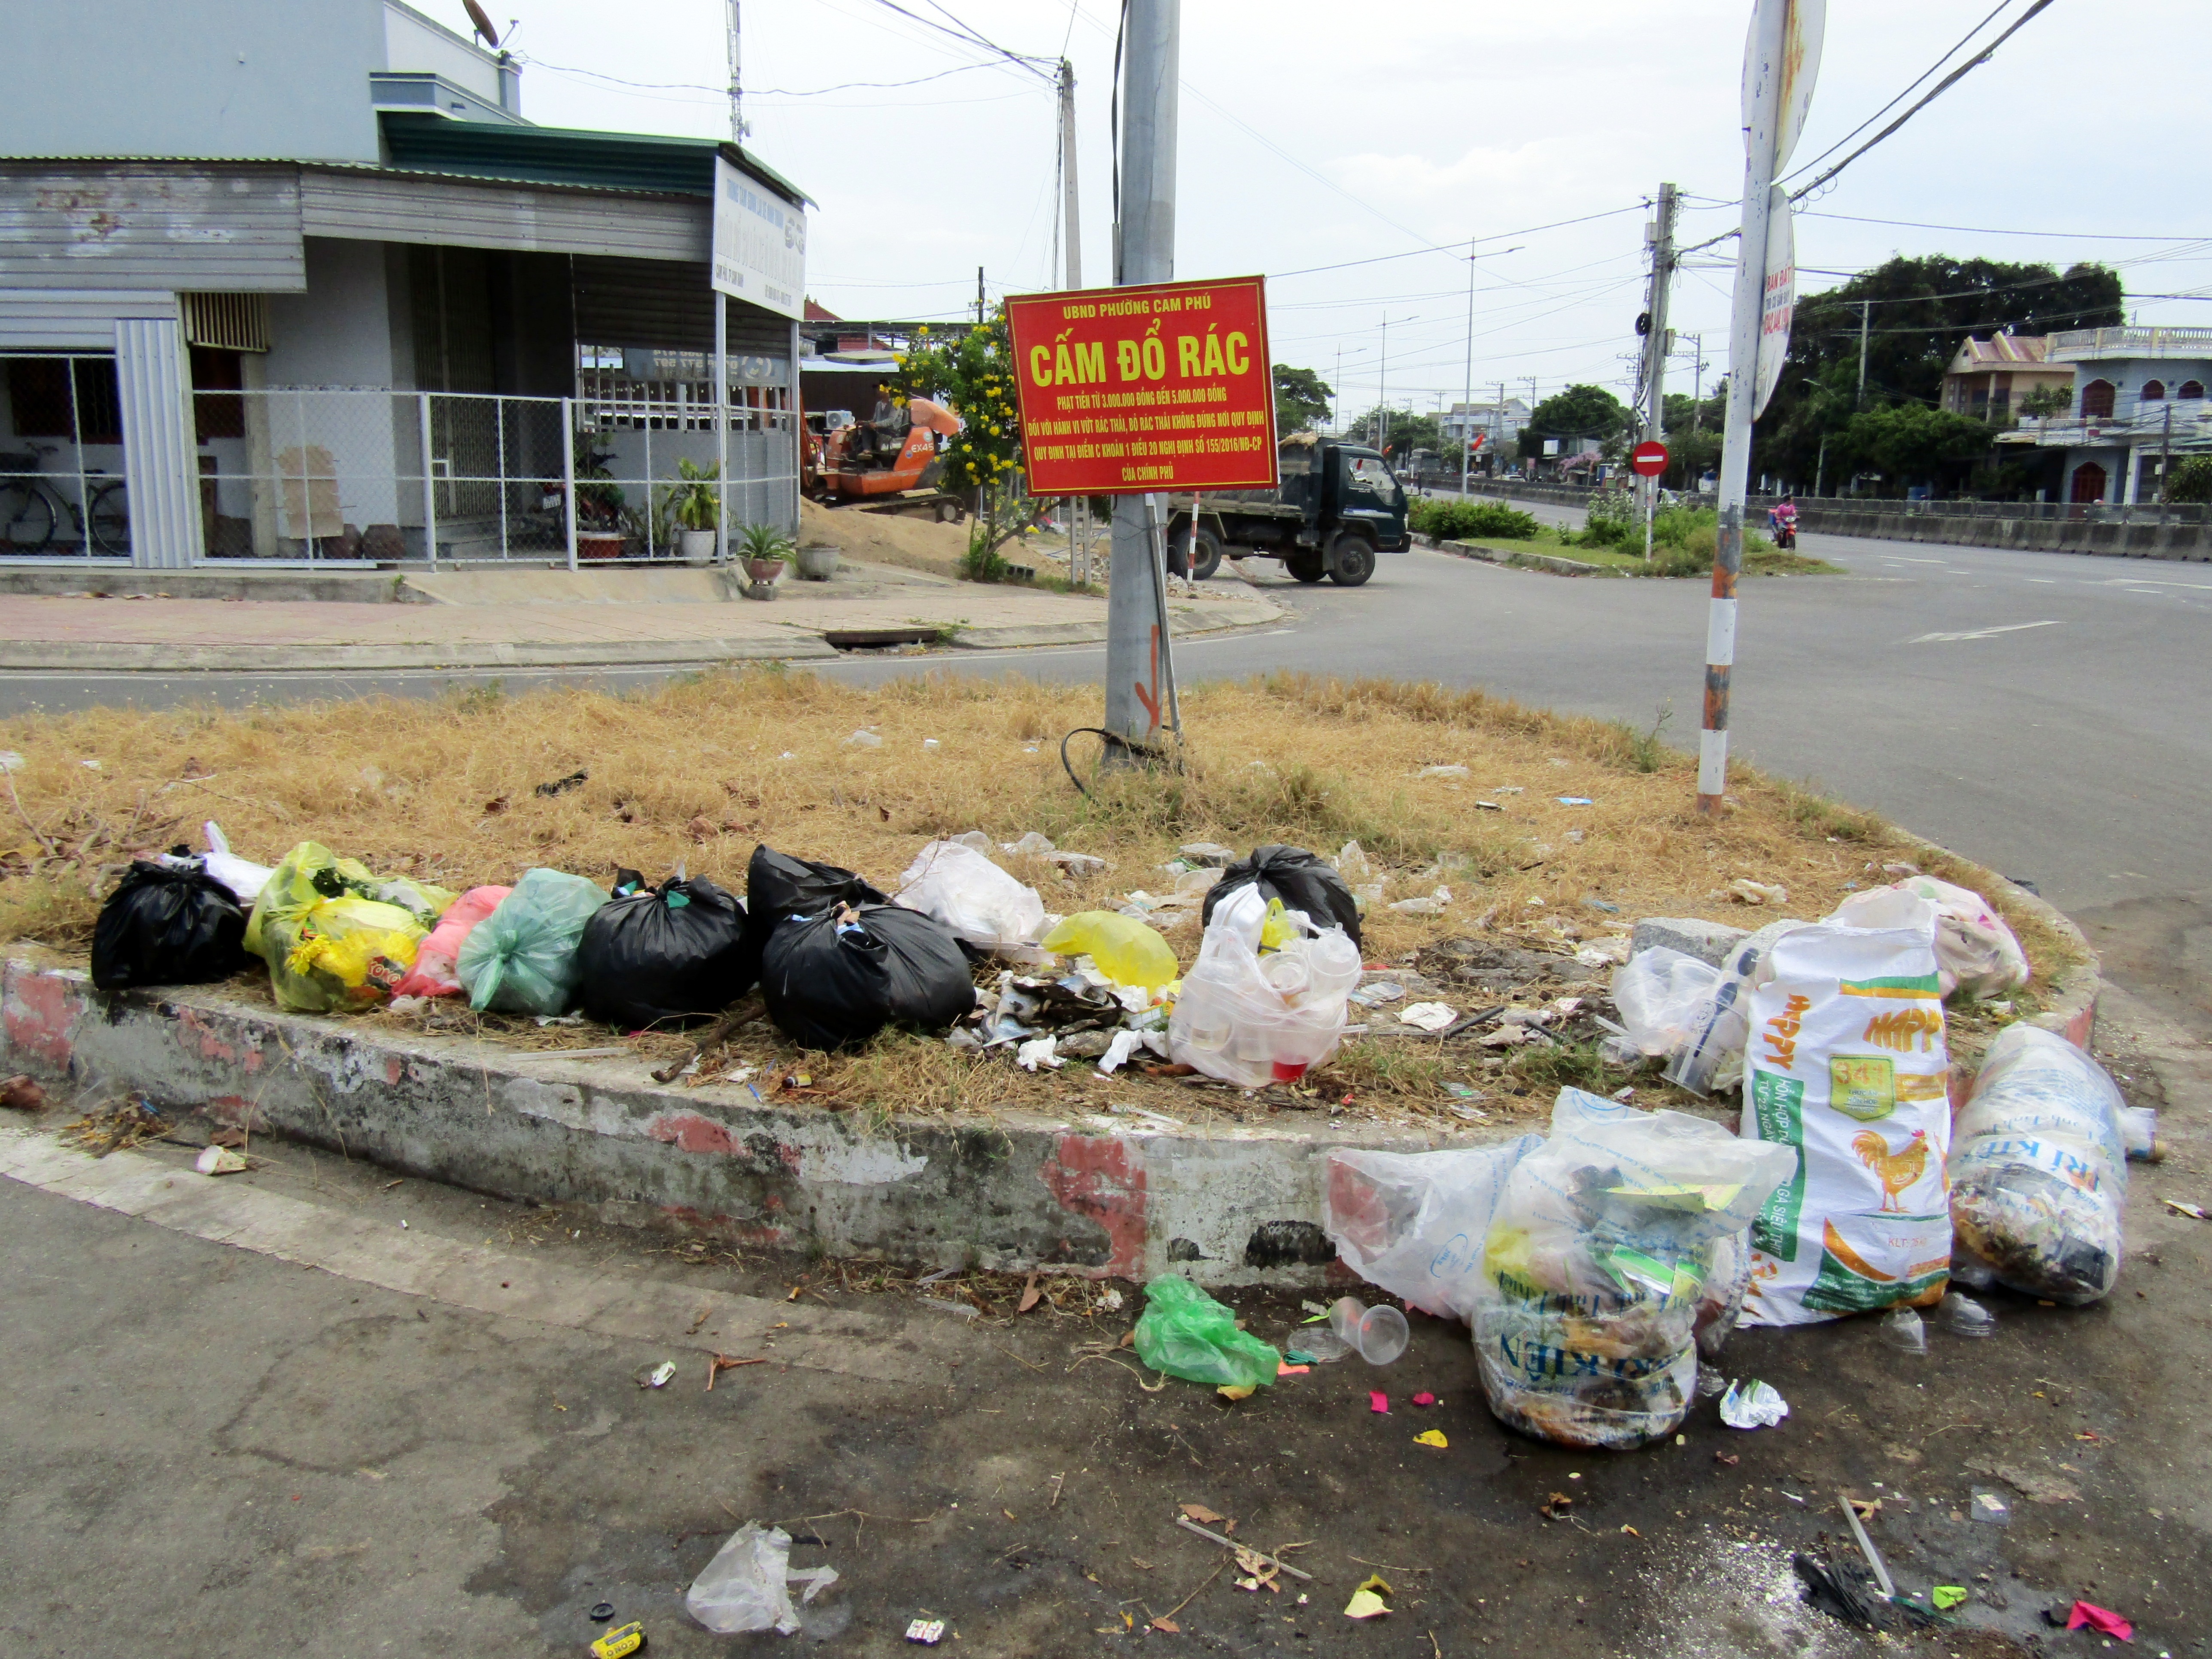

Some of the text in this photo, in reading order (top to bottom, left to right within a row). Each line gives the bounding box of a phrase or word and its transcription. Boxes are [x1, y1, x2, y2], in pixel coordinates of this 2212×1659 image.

[1063, 292, 1211, 319] UBND PHƯỜNG CAM PHÚ
[1030, 318, 1250, 387] CẤM ĐỔ RÁC
[1057, 382, 1227, 413] PHẠT TIỀN TỪ 3.000.000 ĐỒNG ĐẾN 5.000.000 ĐỒNG
[1028, 410, 1264, 436] ĐỐI VỚI HÀNH VI VỨT RÁC THẢI, BỎ RÁC THẢI KHÔNG ĐÚNG NƠI QUY ĐỊNH
[911, 443, 934, 453] EX45
[1034, 434, 1262, 463] QUY ĐỊNH TẠI ĐIỂM C KHOẢN 1 ĐIỀU 20 NGHỊ ĐỊNH SỐ 155/2016/NĐ-CP
[1121, 461, 1173, 481] CỦA CHÍNH PHỦ
[1762, 993, 1811, 1071] HAPPY
[1834, 1061, 1884, 1086] 341
[1758, 1097, 1767, 1110] 22
[1772, 1103, 1791, 1128] HỢP
[1774, 1188, 1792, 1203] GÀ
[1770, 1205, 1787, 1231] SIÊU
